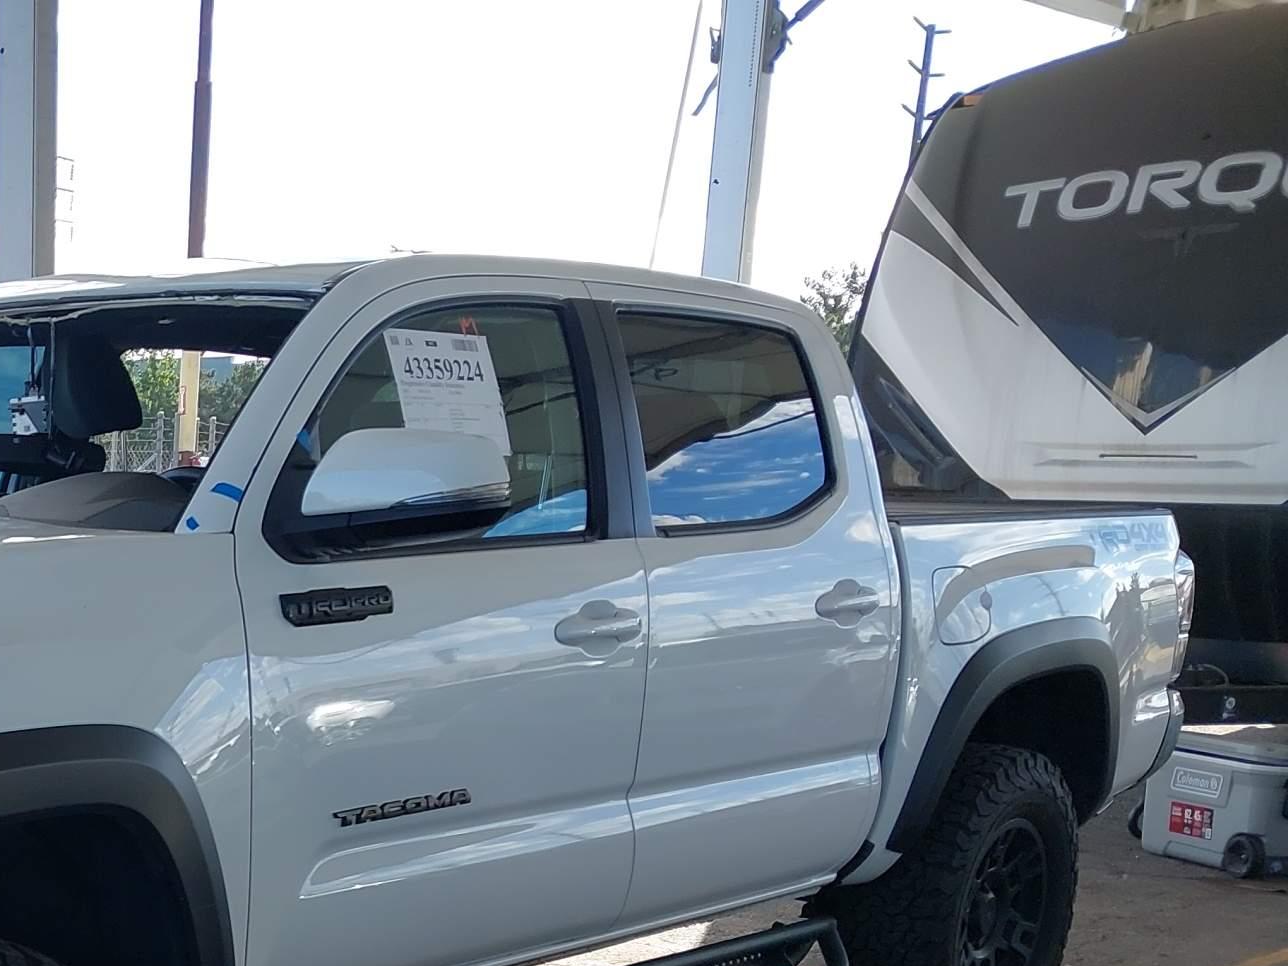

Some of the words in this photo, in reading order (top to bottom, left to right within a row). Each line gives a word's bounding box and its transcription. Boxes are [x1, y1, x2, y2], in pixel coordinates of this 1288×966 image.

[1004, 150, 1288, 229] TORQ
[403, 355, 485, 383] 43359224
[333, 788, 472, 827] TACOMA
